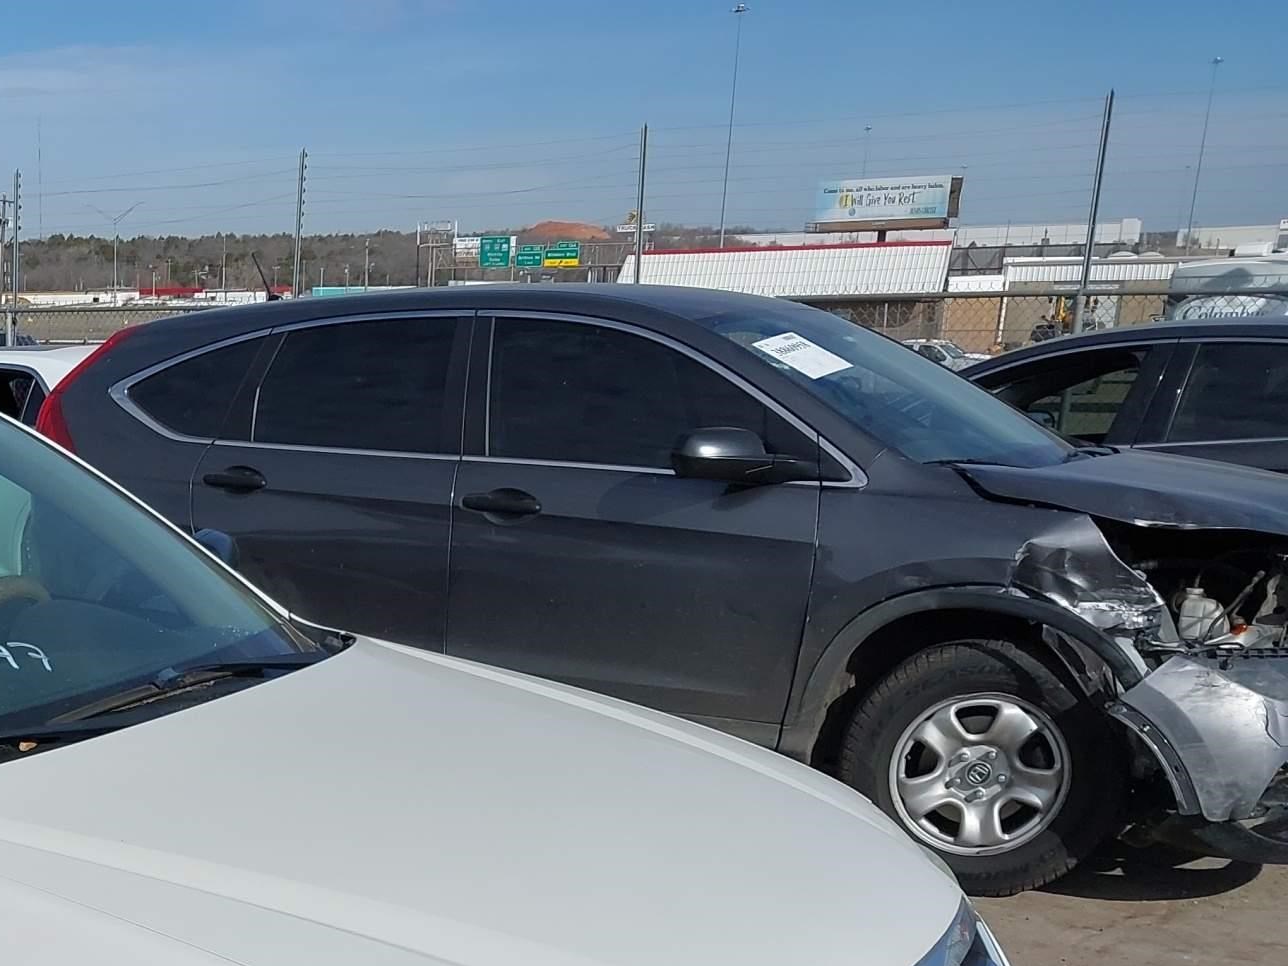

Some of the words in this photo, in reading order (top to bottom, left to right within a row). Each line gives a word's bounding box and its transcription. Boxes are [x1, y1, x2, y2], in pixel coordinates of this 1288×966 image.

[851, 193, 864, 207] Will
[866, 192, 881, 207] Give
[883, 192, 897, 206] You
[898, 190, 922, 206] Rest
